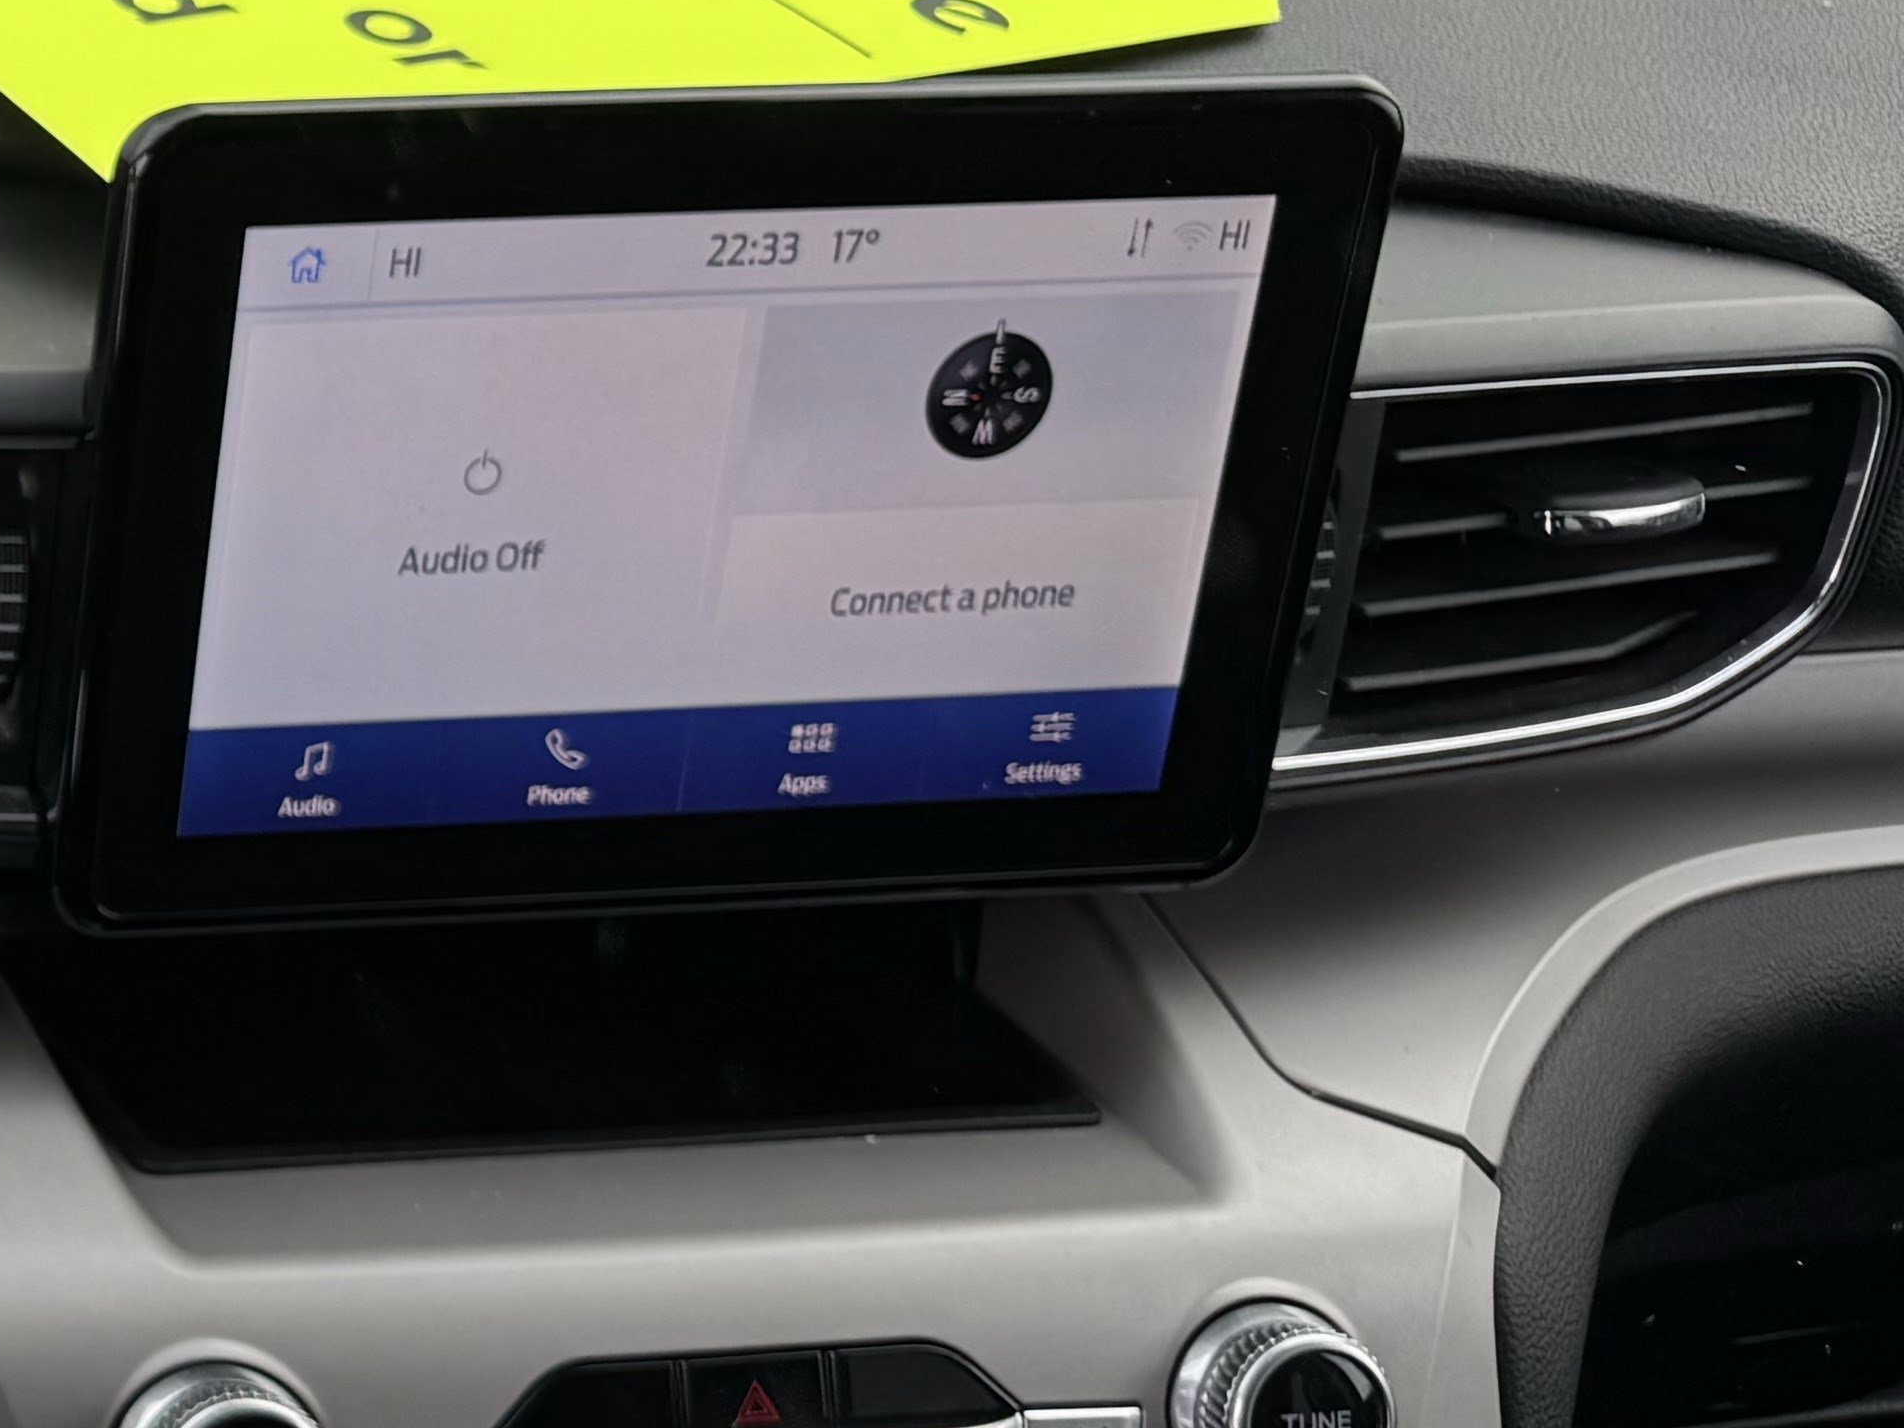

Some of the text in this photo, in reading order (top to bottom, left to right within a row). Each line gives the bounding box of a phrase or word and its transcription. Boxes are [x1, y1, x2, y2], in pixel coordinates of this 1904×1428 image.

[342, 8, 490, 70] or
[705, 228, 882, 268] 22:33 17°
[1216, 218, 1252, 250] HI
[389, 247, 423, 278] HI
[397, 539, 546, 576] Audio Off
[830, 580, 1076, 618] Connect a phone
[526, 783, 591, 807] Phone
[777, 772, 832, 797] Apps
[277, 794, 340, 818] Audio
